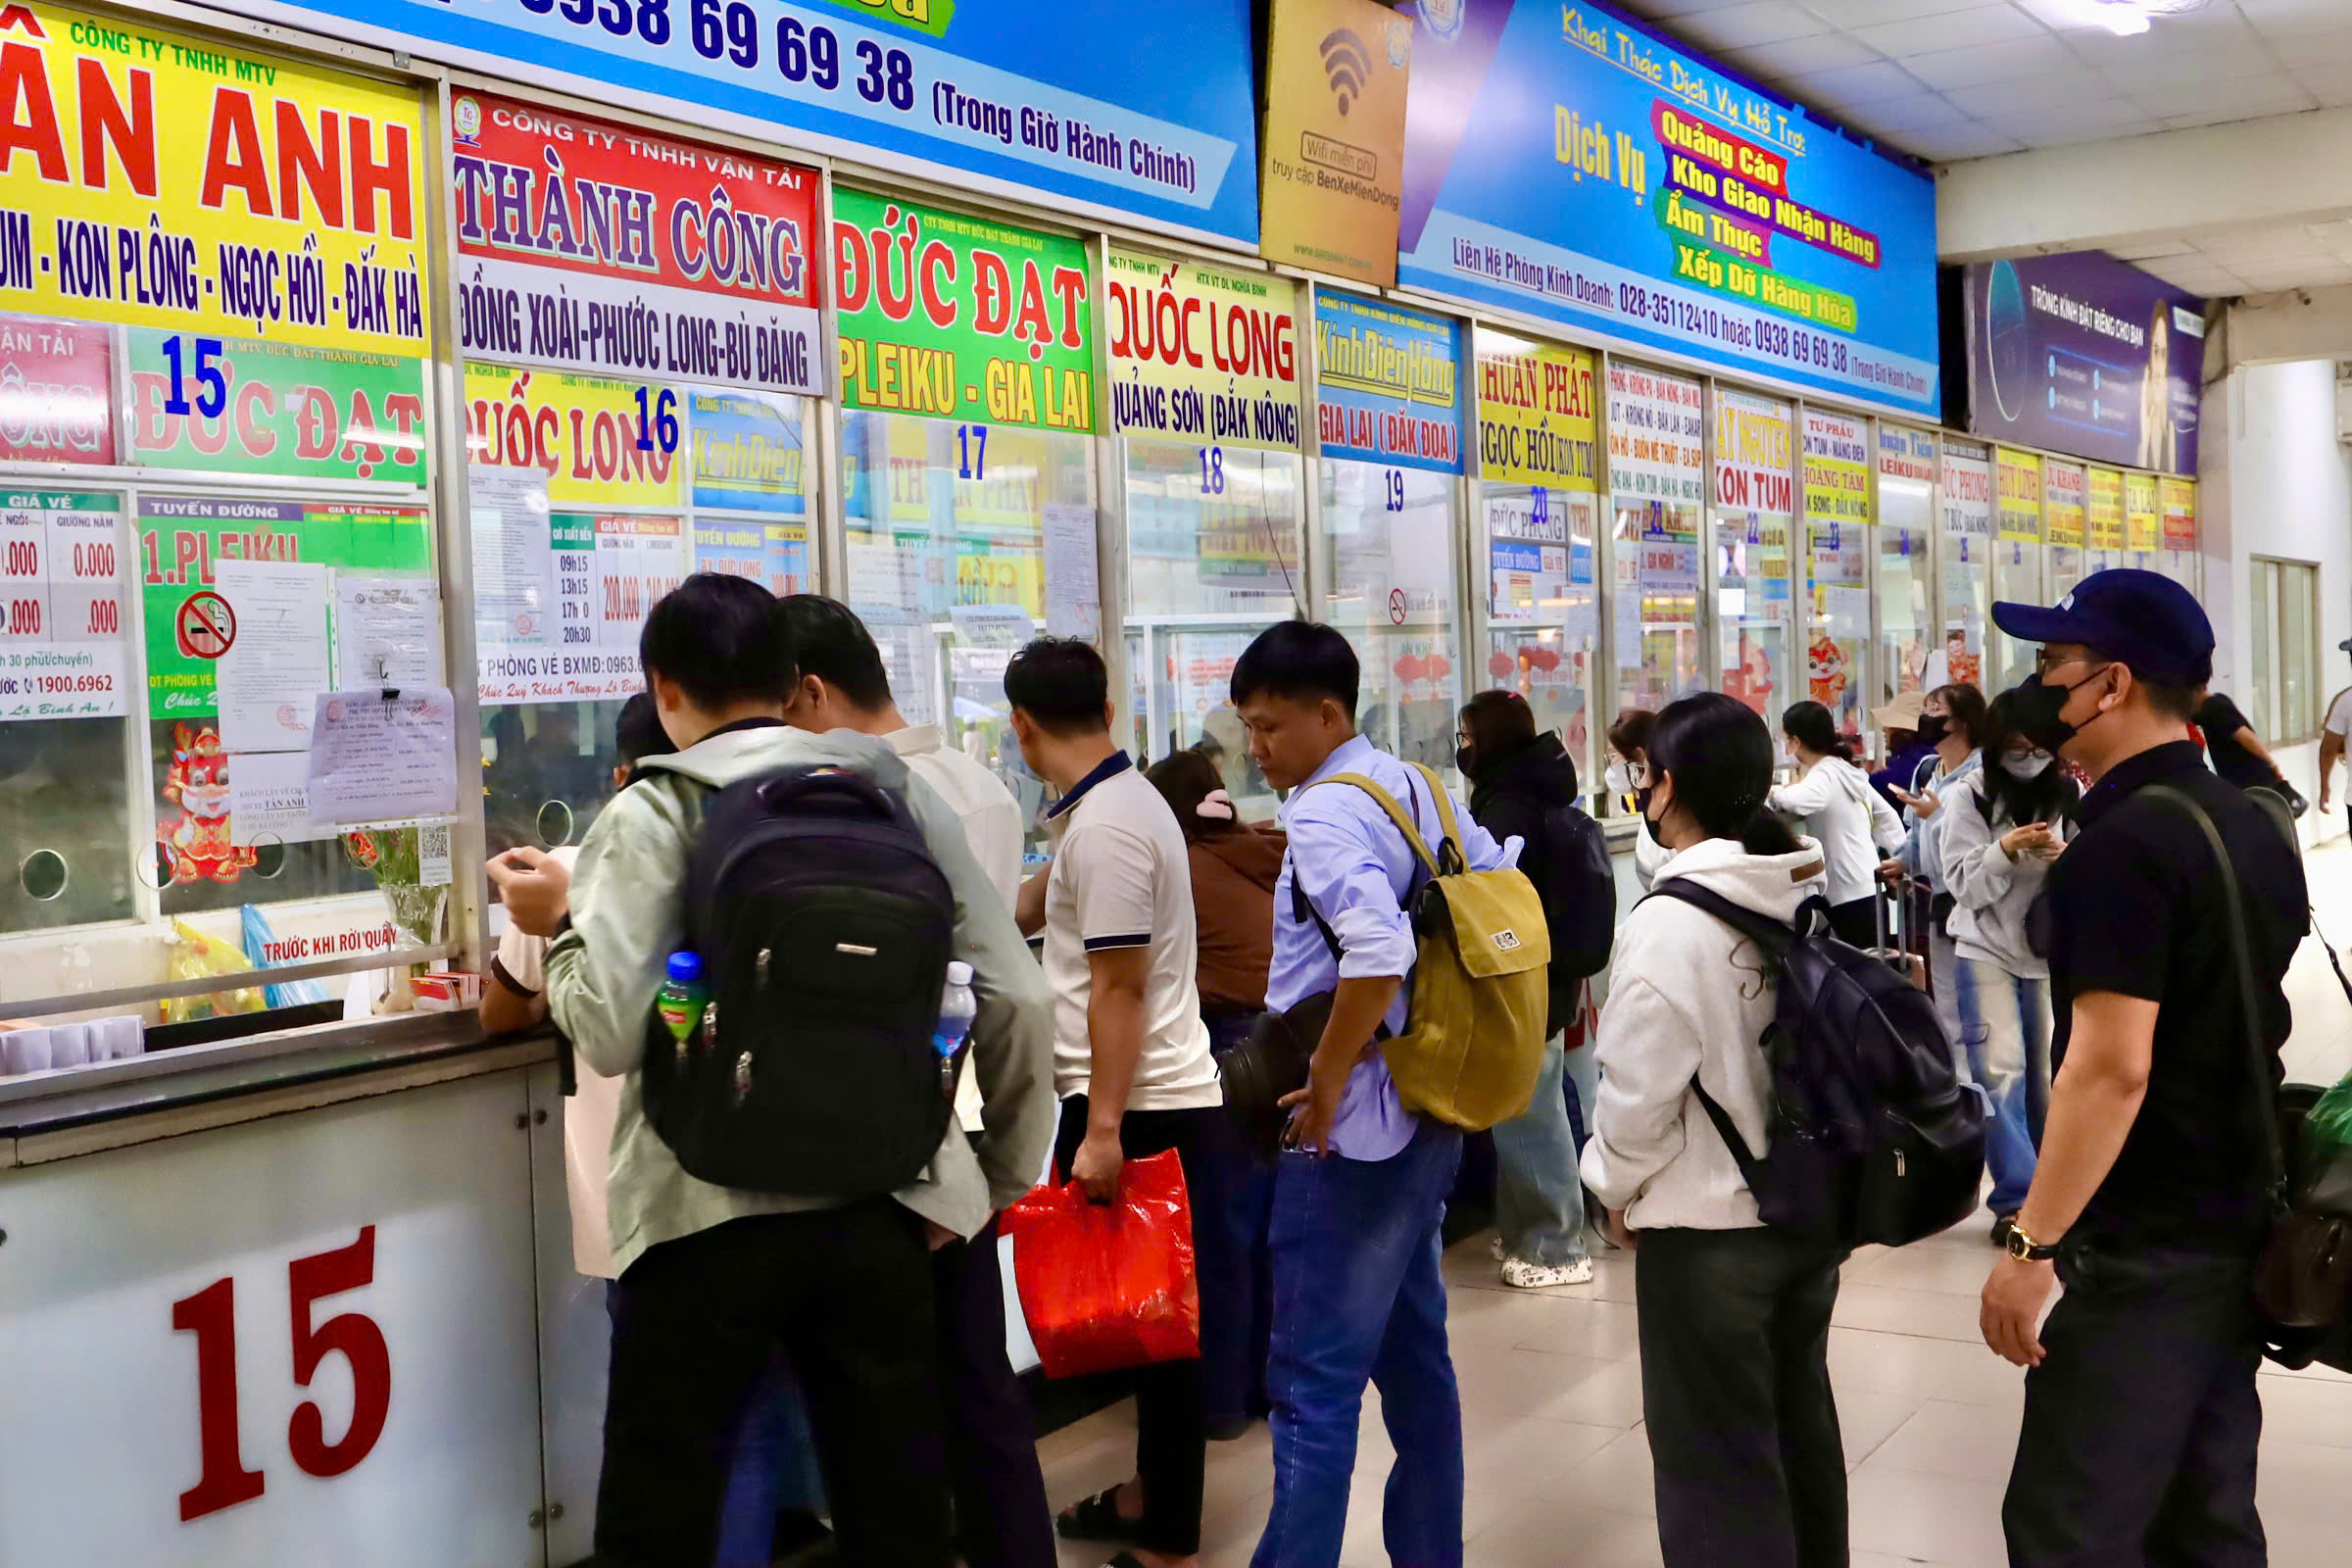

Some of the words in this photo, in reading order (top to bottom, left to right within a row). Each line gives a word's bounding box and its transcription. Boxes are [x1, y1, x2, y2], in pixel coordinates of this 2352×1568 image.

[70, 20, 130, 54] CÔNG
[136, 35, 165, 62] TY
[172, 44, 227, 77] TNHH
[235, 62, 276, 86] MTV
[1561, 5, 1607, 53] Khai
[1615, 31, 1663, 81] Thác
[1670, 60, 1708, 105] Dịch
[1714, 84, 1739, 122] Vụ
[691, 2, 759, 69] 69
[776, 17, 840, 90] 69
[857, 39, 913, 111] 38
[933, 81, 1012, 144] (Trong
[1020, 106, 1058, 153] Giờ
[1066, 121, 1122, 171] Hành
[1129, 141, 1197, 194] Chính)
[201, 87, 413, 239] ANH
[492, 108, 574, 142] CÔNG
[583, 128, 616, 150] TY
[625, 138, 697, 170] TNHH
[704, 156, 755, 183] VẬN
[762, 168, 802, 191] TẢI
[1554, 104, 1610, 182] Dịch
[1617, 131, 1646, 207] Vụ
[1661, 111, 1734, 171] Quảng
[1740, 146, 1781, 186] Cáo
[1273, 158, 1294, 181] truy
[1296, 164, 1315, 186] cập
[1317, 170, 1399, 212] BenXeMienDong
[1672, 155, 1717, 198] Kho
[1722, 176, 1772, 220] Giao
[1776, 199, 1827, 242] Nhận
[1830, 224, 1876, 263] Hàng
[454, 144, 659, 274] THÀNH
[671, 183, 807, 298] CÔNG
[1710, 216, 1762, 260] Thực
[58, 219, 111, 300] KON
[119, 213, 199, 312] PLÔNG
[219, 243, 280, 334] NGỌC
[287, 233, 325, 326] HỒI
[345, 245, 389, 335] ĐẮK
[395, 254, 423, 338] HÀ
[834, 204, 956, 327] ĐỨC
[971, 249, 1087, 361] ĐẠT
[1452, 237, 1481, 270] Liên
[1485, 249, 1502, 282] Hệ
[1505, 257, 1544, 291] Phòng
[1546, 265, 1573, 296] Kinh
[1576, 273, 1615, 309] Doanh:
[1619, 282, 1718, 339] 028-35112410
[1722, 313, 1752, 353] hoặc
[1755, 318, 1788, 360] 0938
[1793, 331, 1810, 363] 69
[1813, 338, 1829, 369] 69
[1832, 343, 1847, 373] 38
[1679, 244, 1724, 287] Xếp
[1762, 271, 1813, 318] Hàng
[1817, 290, 1852, 327] Hóa
[38, 329, 74, 356] TẢI
[461, 263, 521, 354] ĐỒNG
[758, 318, 808, 388] ĐĂNG
[1109, 264, 1203, 368] QUỐC
[1209, 301, 1295, 382] LONG
[162, 335, 226, 418] 15
[839, 336, 956, 416] PLEIKU
[986, 357, 1037, 424] GIA
[1044, 366, 1090, 429] LAI
[1544, 353, 1592, 418] PHÁT
[294, 385, 422, 479] ĐẠT
[464, 370, 560, 478] UỐC
[569, 408, 672, 484] LONG
[635, 385, 678, 454] 16
[1171, 385, 1204, 434] SƠN
[1210, 377, 1250, 441] (ĐẮK
[1254, 389, 1299, 450] NÔNG)
[1318, 403, 1346, 444] GIA
[1349, 407, 1373, 448] LAI
[1526, 416, 1556, 472] HỒI
[957, 424, 987, 479] 17
[1199, 446, 1224, 495] 18
[9, 494, 41, 509] GIÁ
[48, 495, 73, 510] VÉ
[151, 498, 213, 517] TUYẾN
[218, 503, 279, 519] ĐƯỜNG
[1385, 468, 1403, 513] 19
[1531, 486, 1547, 524] 20
[1754, 472, 1790, 513] TUM
[1747, 512, 1759, 544] 22
[561, 555, 588, 572] 09h15
[562, 578, 588, 595] 13h15
[487, 654, 537, 677] PHÒNG
[541, 653, 559, 675] VÉ
[564, 626, 591, 643] 20h30
[37, 674, 113, 694] 1900.6962
[265, 937, 309, 962] TRƯỚC
[313, 933, 335, 954] KHI
[340, 927, 362, 952] RỜI
[173, 1224, 391, 1522] 15
